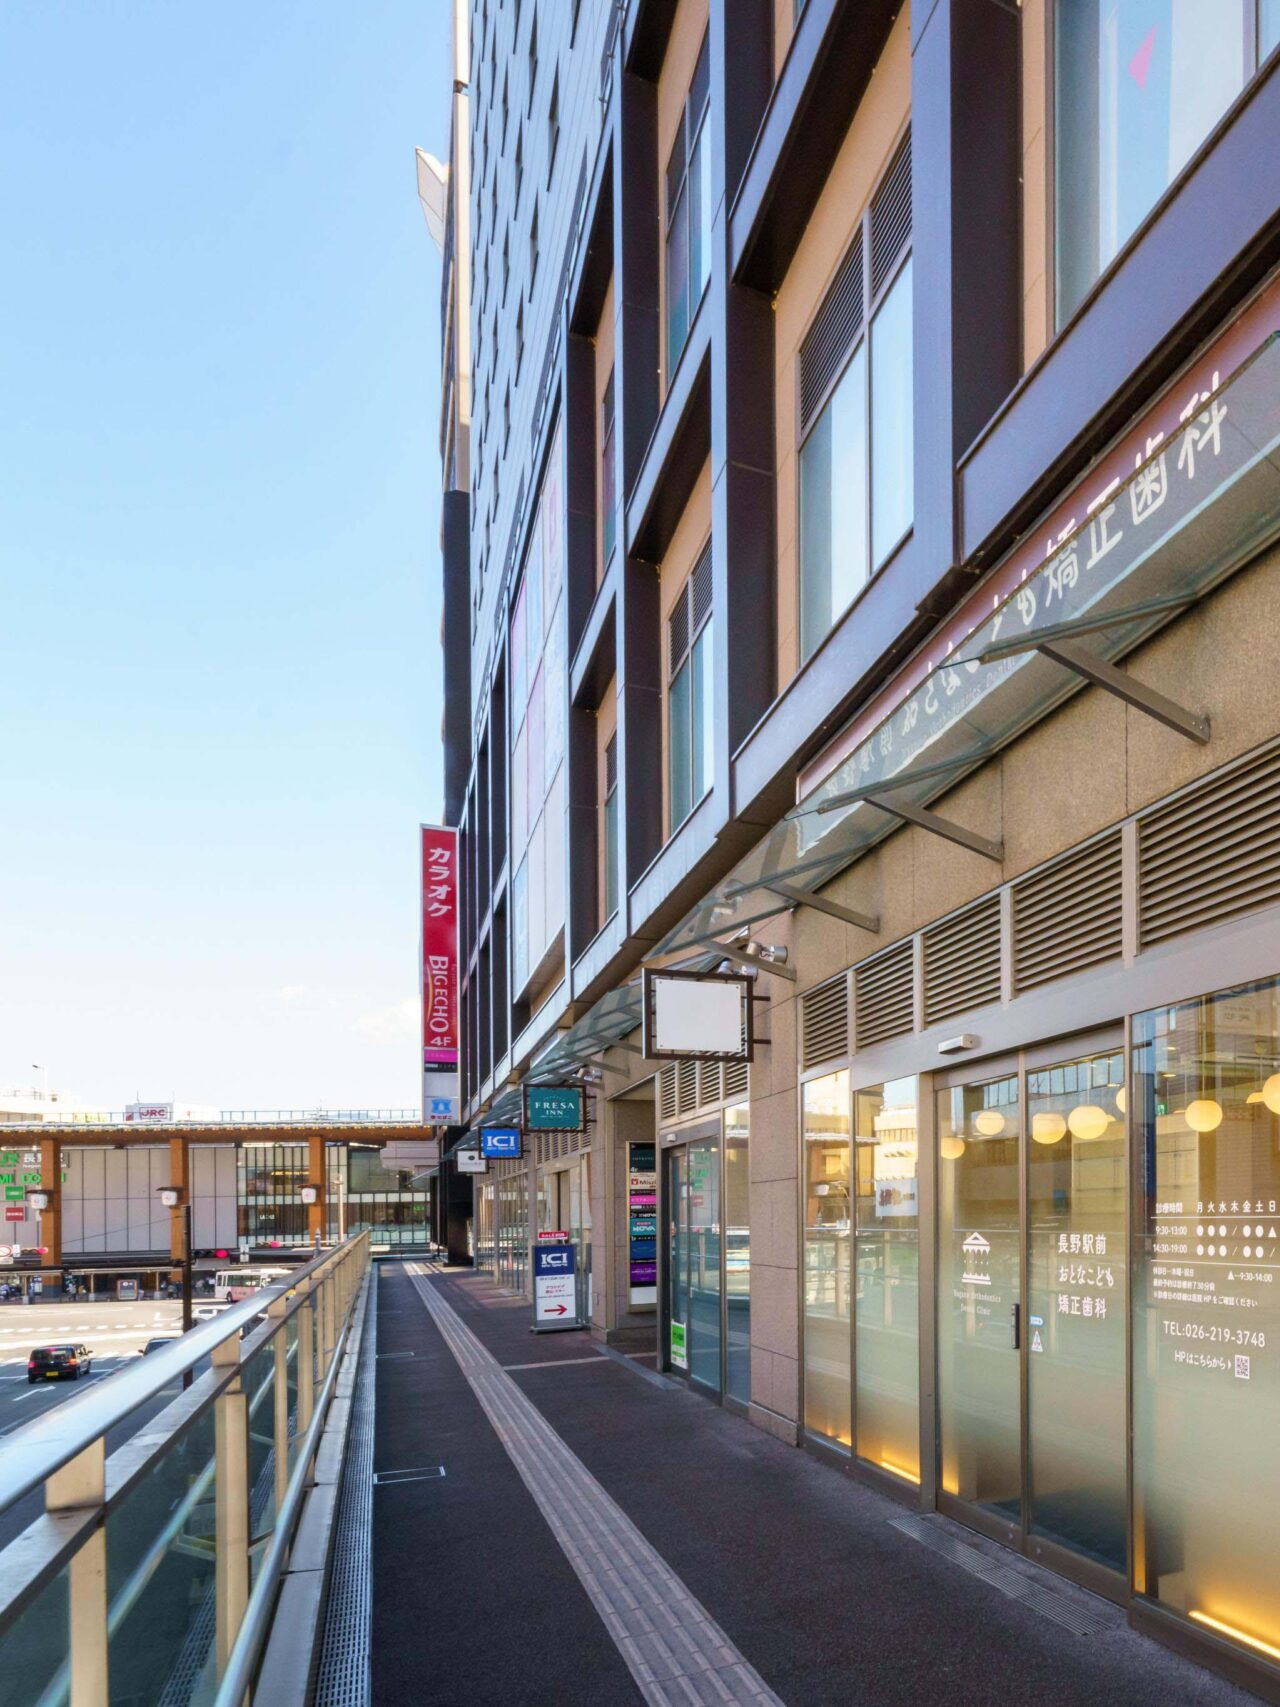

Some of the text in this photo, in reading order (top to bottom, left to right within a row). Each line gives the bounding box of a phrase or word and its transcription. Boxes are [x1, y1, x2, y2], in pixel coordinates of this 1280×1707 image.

[428, 848, 452, 917] カラオケ
[429, 955, 449, 986] BIG
[429, 988, 449, 1033] ECHO
[430, 1036, 452, 1046] 4F
[487, 1136, 515, 1147] ICI
[1196, 1201, 1204, 1213] 月
[1207, 1201, 1216, 1213] 火
[1218, 1201, 1227, 1213] 水
[1230, 1200, 1239, 1213] 木
[1242, 1200, 1251, 1213] 金
[1255, 1200, 1264, 1212] 土
[1268, 1200, 1276, 1212] 日
[1155, 1225, 1187, 1236] 9:30-13:00
[1058, 1233, 1107, 1255] 長野駅前
[541, 1253, 568, 1265] ICI
[1059, 1264, 1114, 1287] おとなこども
[1058, 1293, 1107, 1319] 矯正歯科
[1163, 1320, 1266, 1348] TEL:026-219-3748
[1174, 1350, 1226, 1370] HPはこちらから
